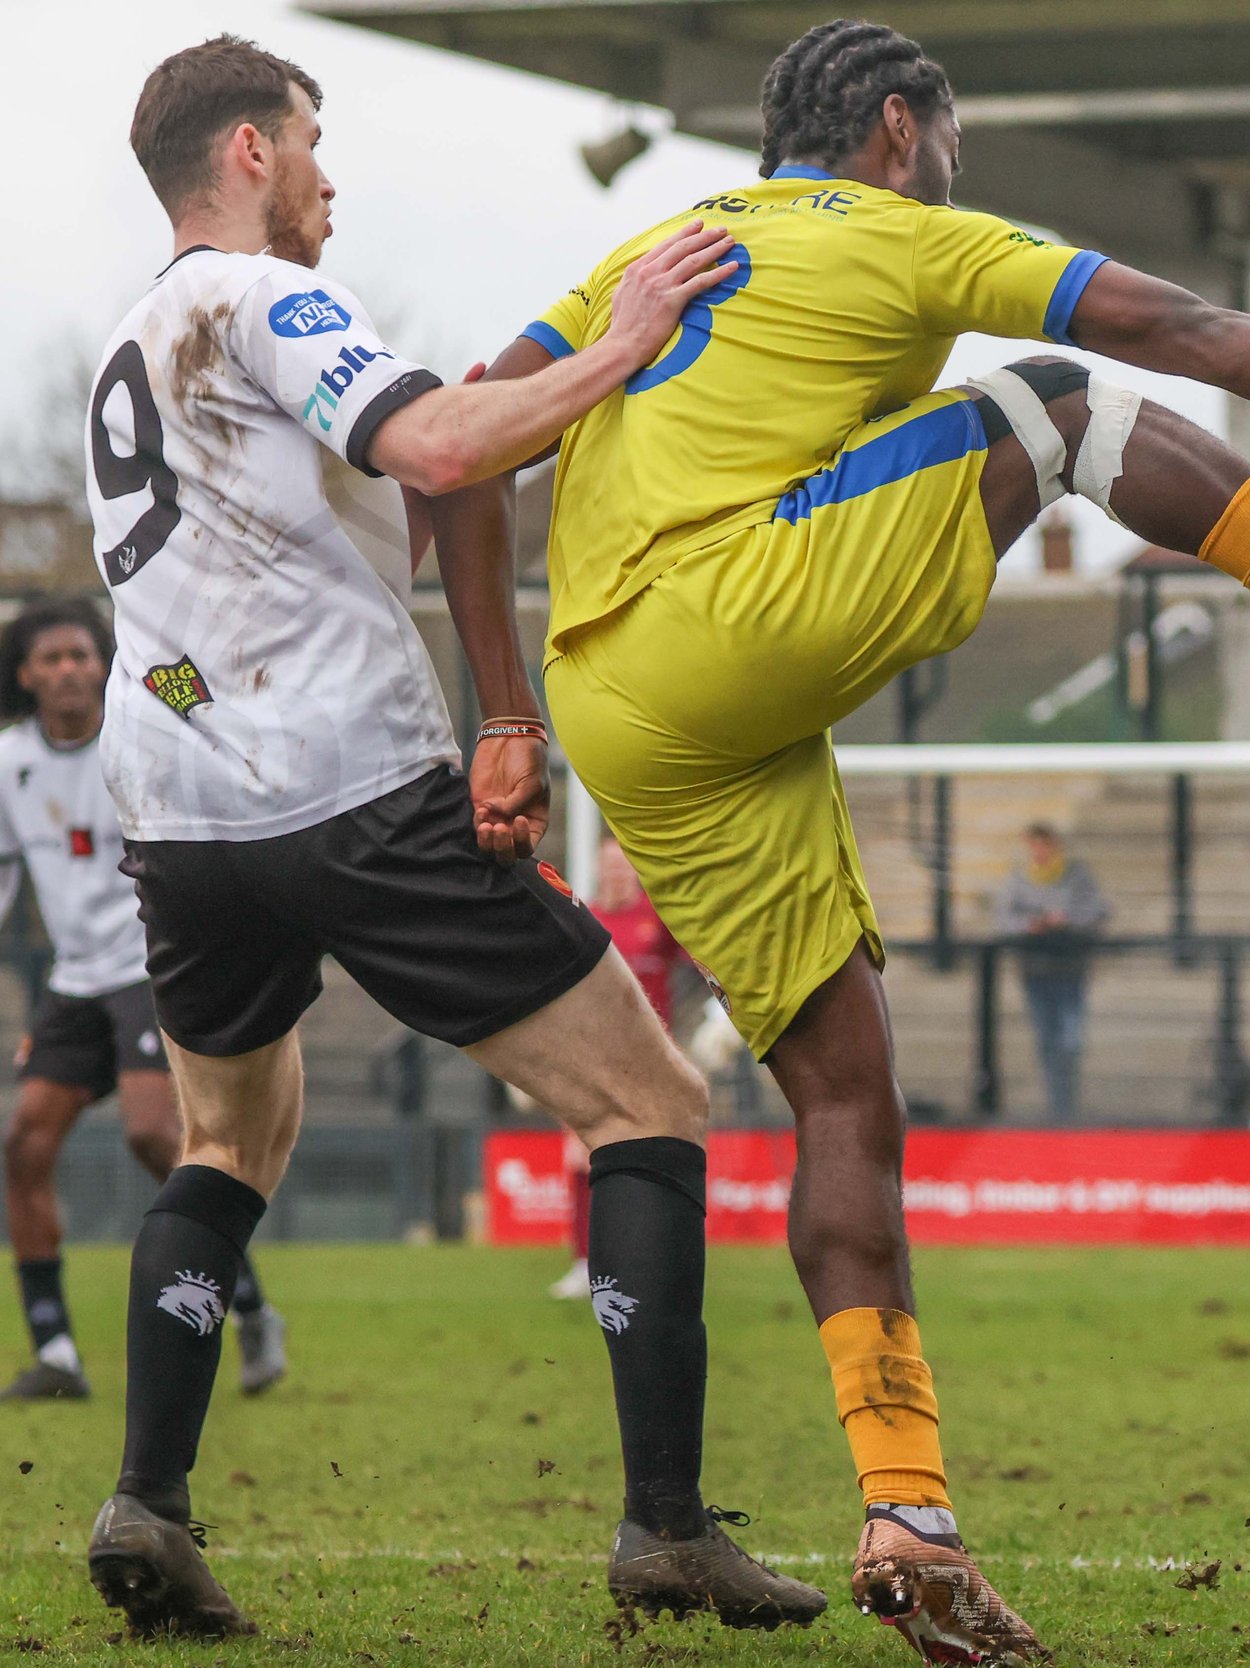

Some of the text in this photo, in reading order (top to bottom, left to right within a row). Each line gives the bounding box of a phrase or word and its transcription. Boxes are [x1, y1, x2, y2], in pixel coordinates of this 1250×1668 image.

[275, 308, 296, 325] THANK
[302, 345, 398, 432] 71blu
[91, 340, 182, 587] 9
[151, 663, 197, 689] BIG
[480, 726, 519, 737] FORGIVEN
